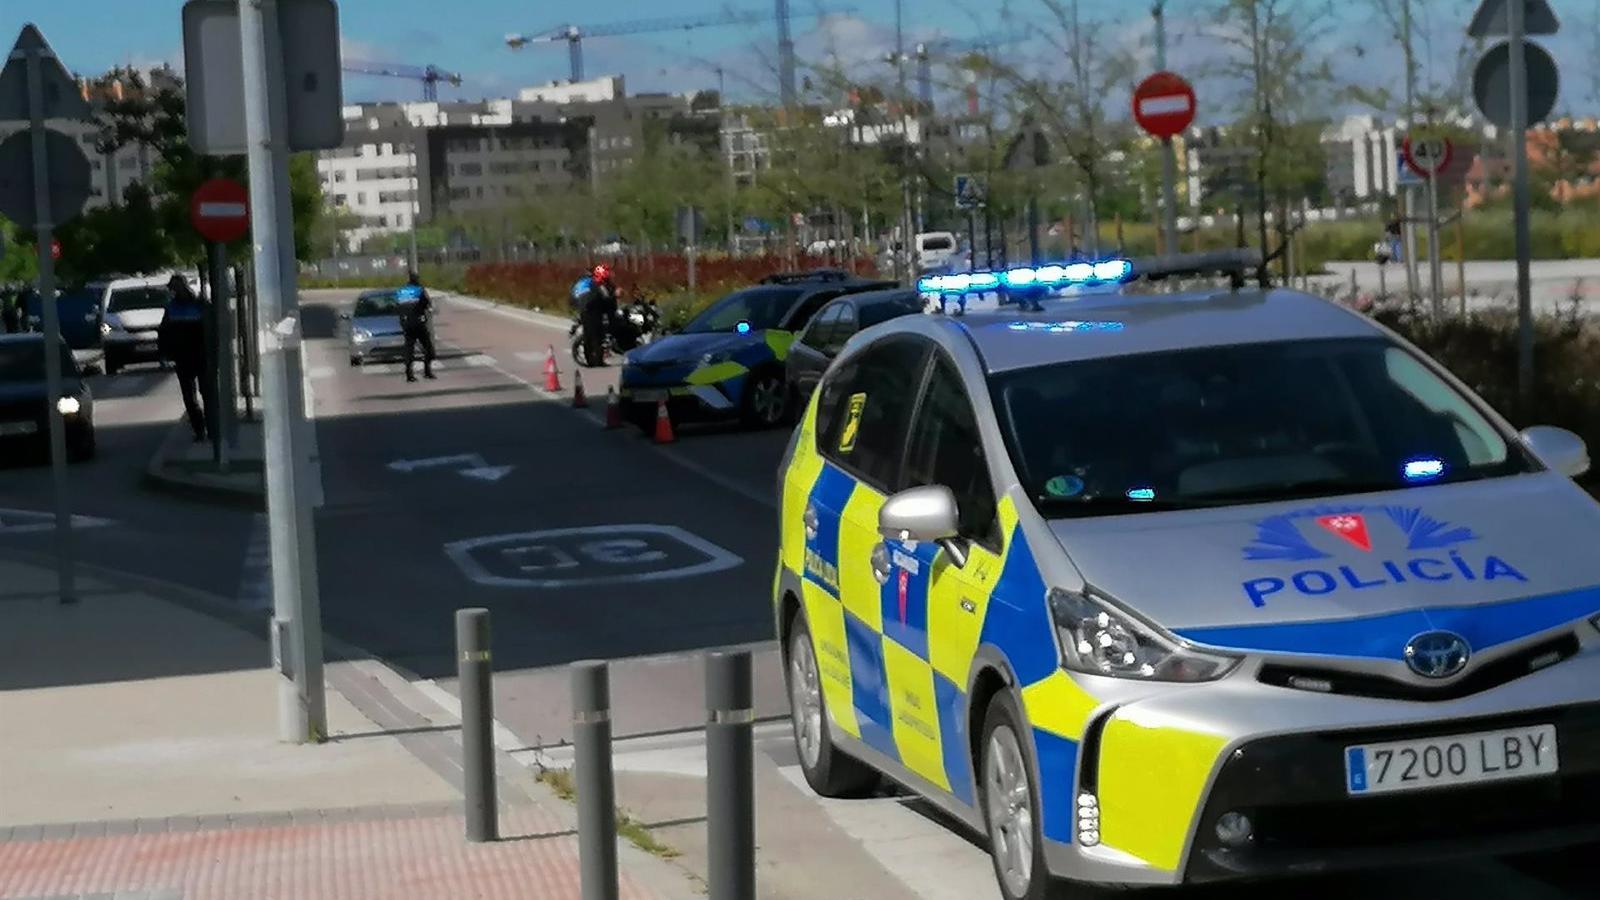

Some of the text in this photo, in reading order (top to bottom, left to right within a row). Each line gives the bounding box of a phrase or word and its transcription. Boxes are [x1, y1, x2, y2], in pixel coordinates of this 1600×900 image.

[1415, 141, 1443, 158] 40
[1242, 551, 1528, 607] POLICÍA
[1375, 733, 1544, 784] 7200 LBY
[1354, 773, 1363, 785] E
